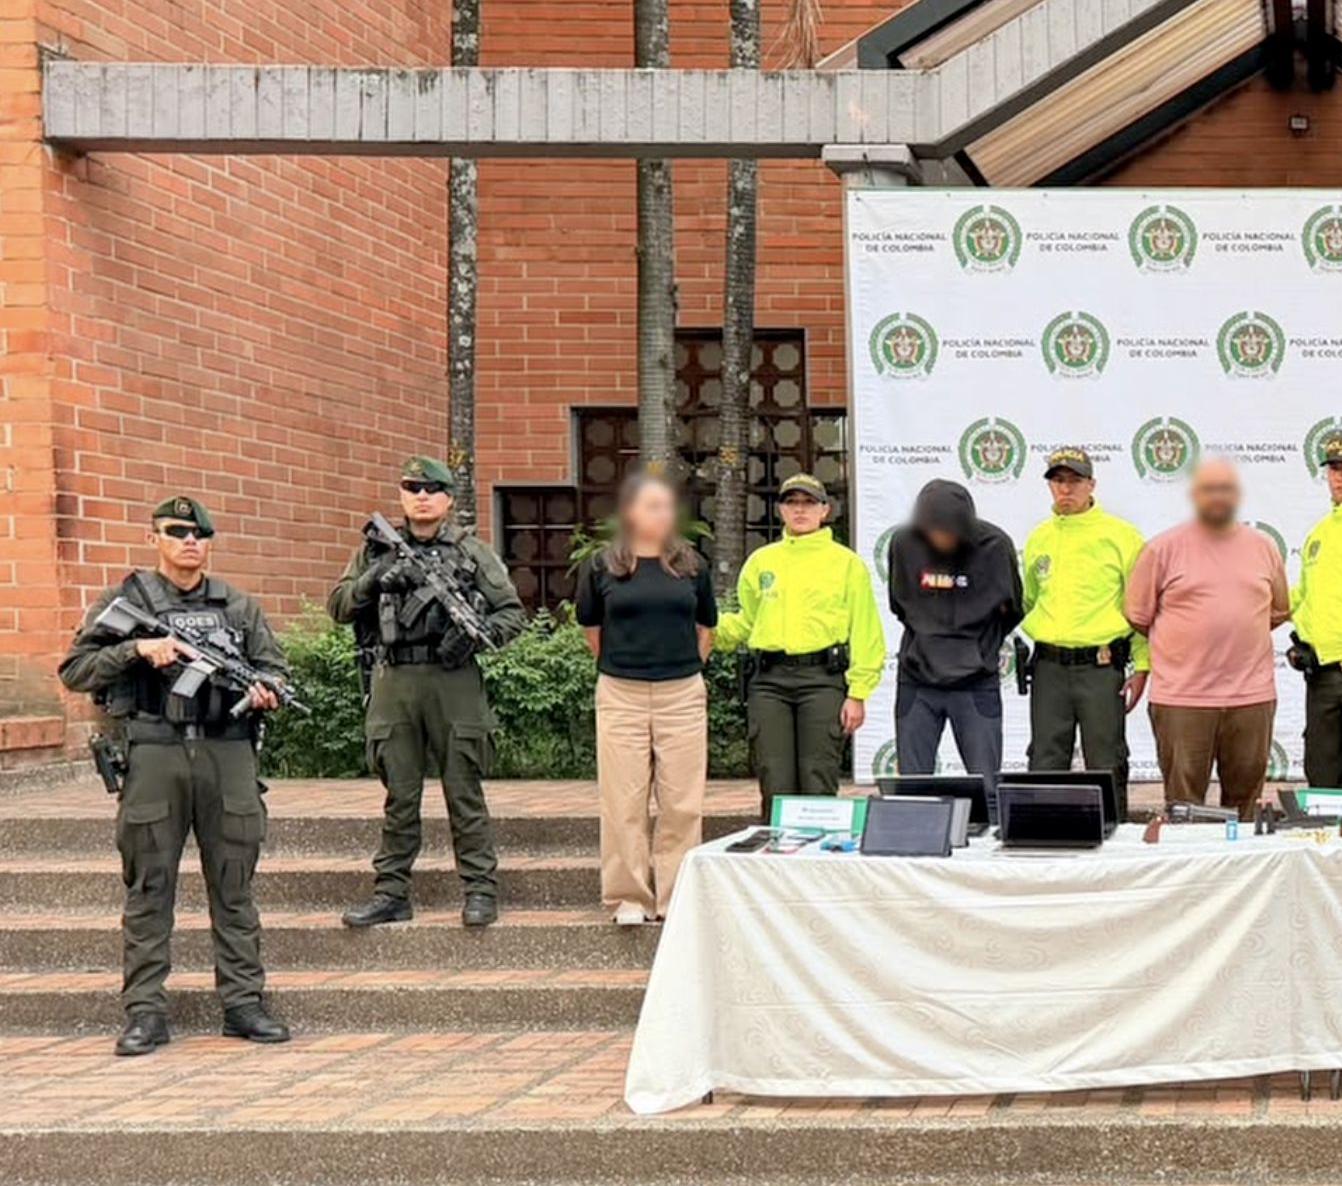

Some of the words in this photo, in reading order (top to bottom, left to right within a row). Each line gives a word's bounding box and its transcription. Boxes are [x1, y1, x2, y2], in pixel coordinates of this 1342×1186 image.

[894, 232, 947, 241] NACIONAL
[1067, 231, 1120, 241] NACIONAL
[1244, 231, 1296, 241] NACIONAL
[865, 243, 879, 253] DE
[881, 243, 935, 253] COLOMBIA
[1039, 243, 1052, 252] DE
[1054, 243, 1108, 252] COLOMBIA
[1215, 243, 1228, 252] DE
[1230, 243, 1284, 252] COLOMBIA
[983, 338, 1035, 348] NACIONAL
[1157, 338, 1210, 347] NACIONAL
[955, 349, 968, 359] DE
[970, 349, 1023, 359] COLOMBIA
[1129, 349, 1142, 358] DE
[1144, 349, 1198, 358] COLOMBIA
[1301, 349, 1315, 358] DE
[872, 455, 885, 465] DE
[888, 455, 941, 465] COLOMBIA
[174, 616, 214, 629] GOES
